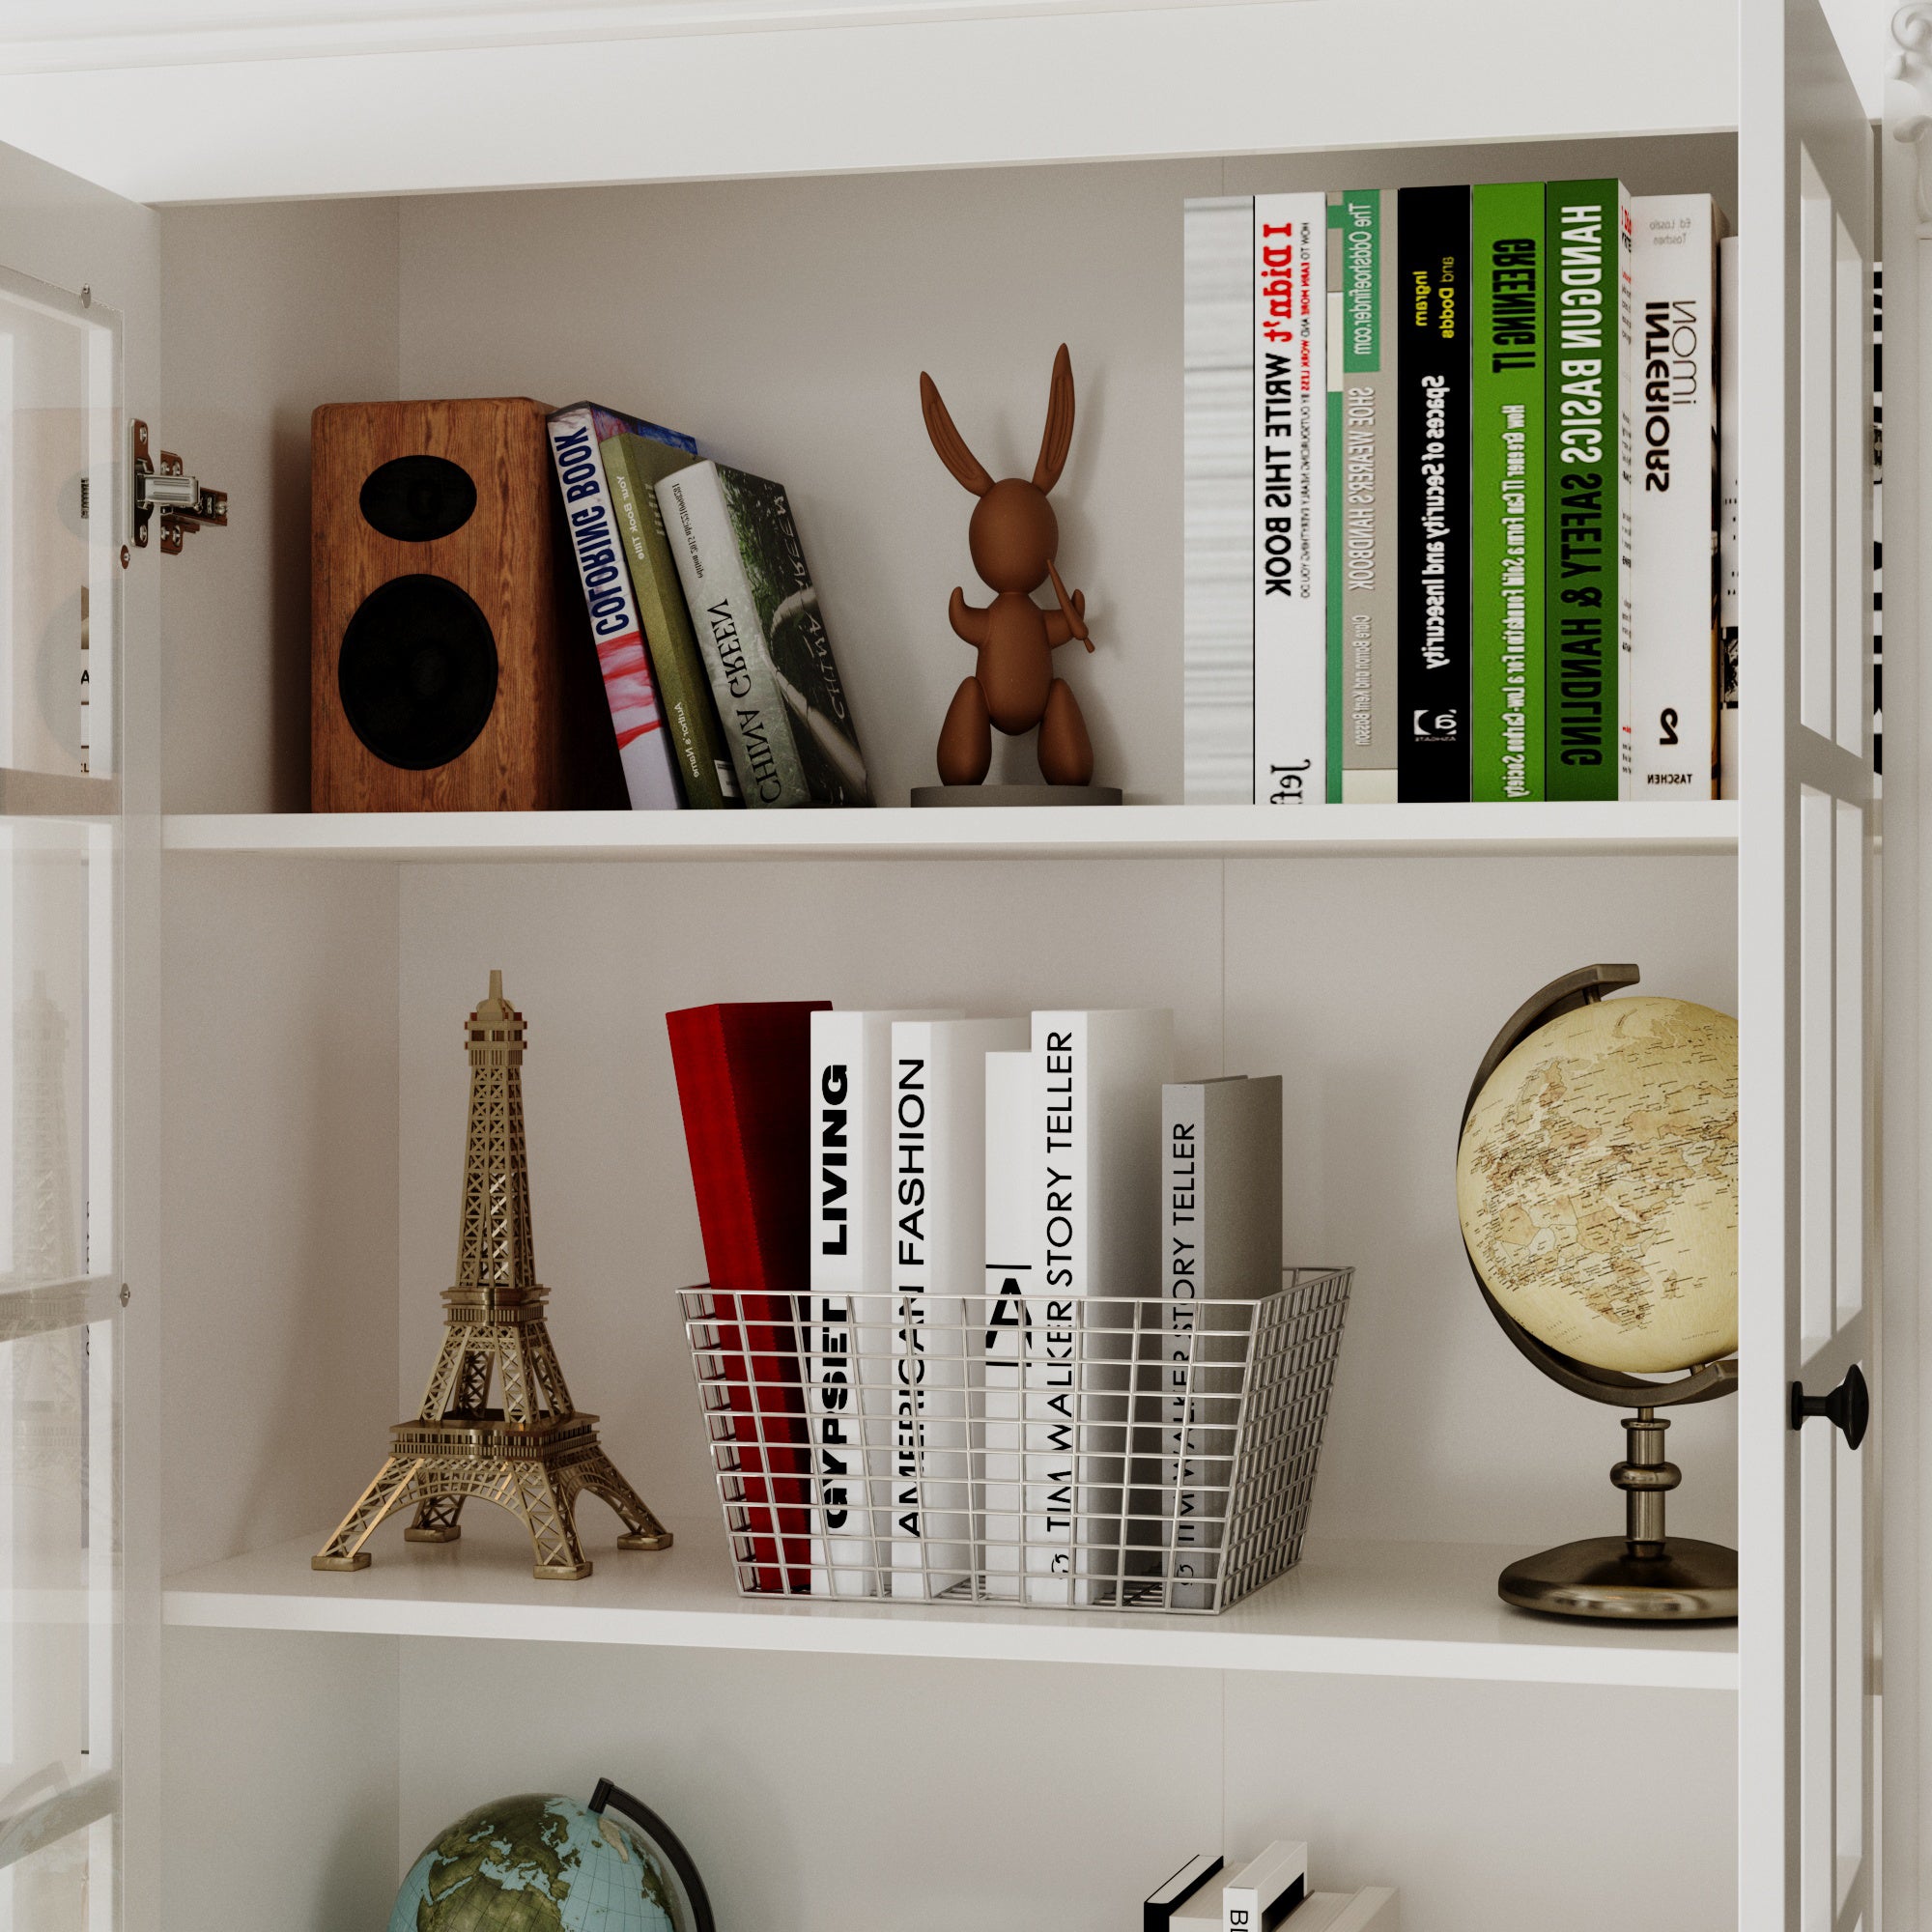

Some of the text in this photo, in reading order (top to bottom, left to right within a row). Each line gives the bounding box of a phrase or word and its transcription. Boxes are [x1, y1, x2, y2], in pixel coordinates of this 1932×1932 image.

[821, 1064, 848, 1529] GYPSET LIVING
[897, 1059, 925, 1538] AMERICAN FASHION
[1046, 1032, 1073, 1532] TIM WALKER STORY TELLER
[1172, 1122, 1196, 1227] TELLER
[1172, 1236, 1196, 1340] STORY
[1230, 1909, 1249, 1932] B
